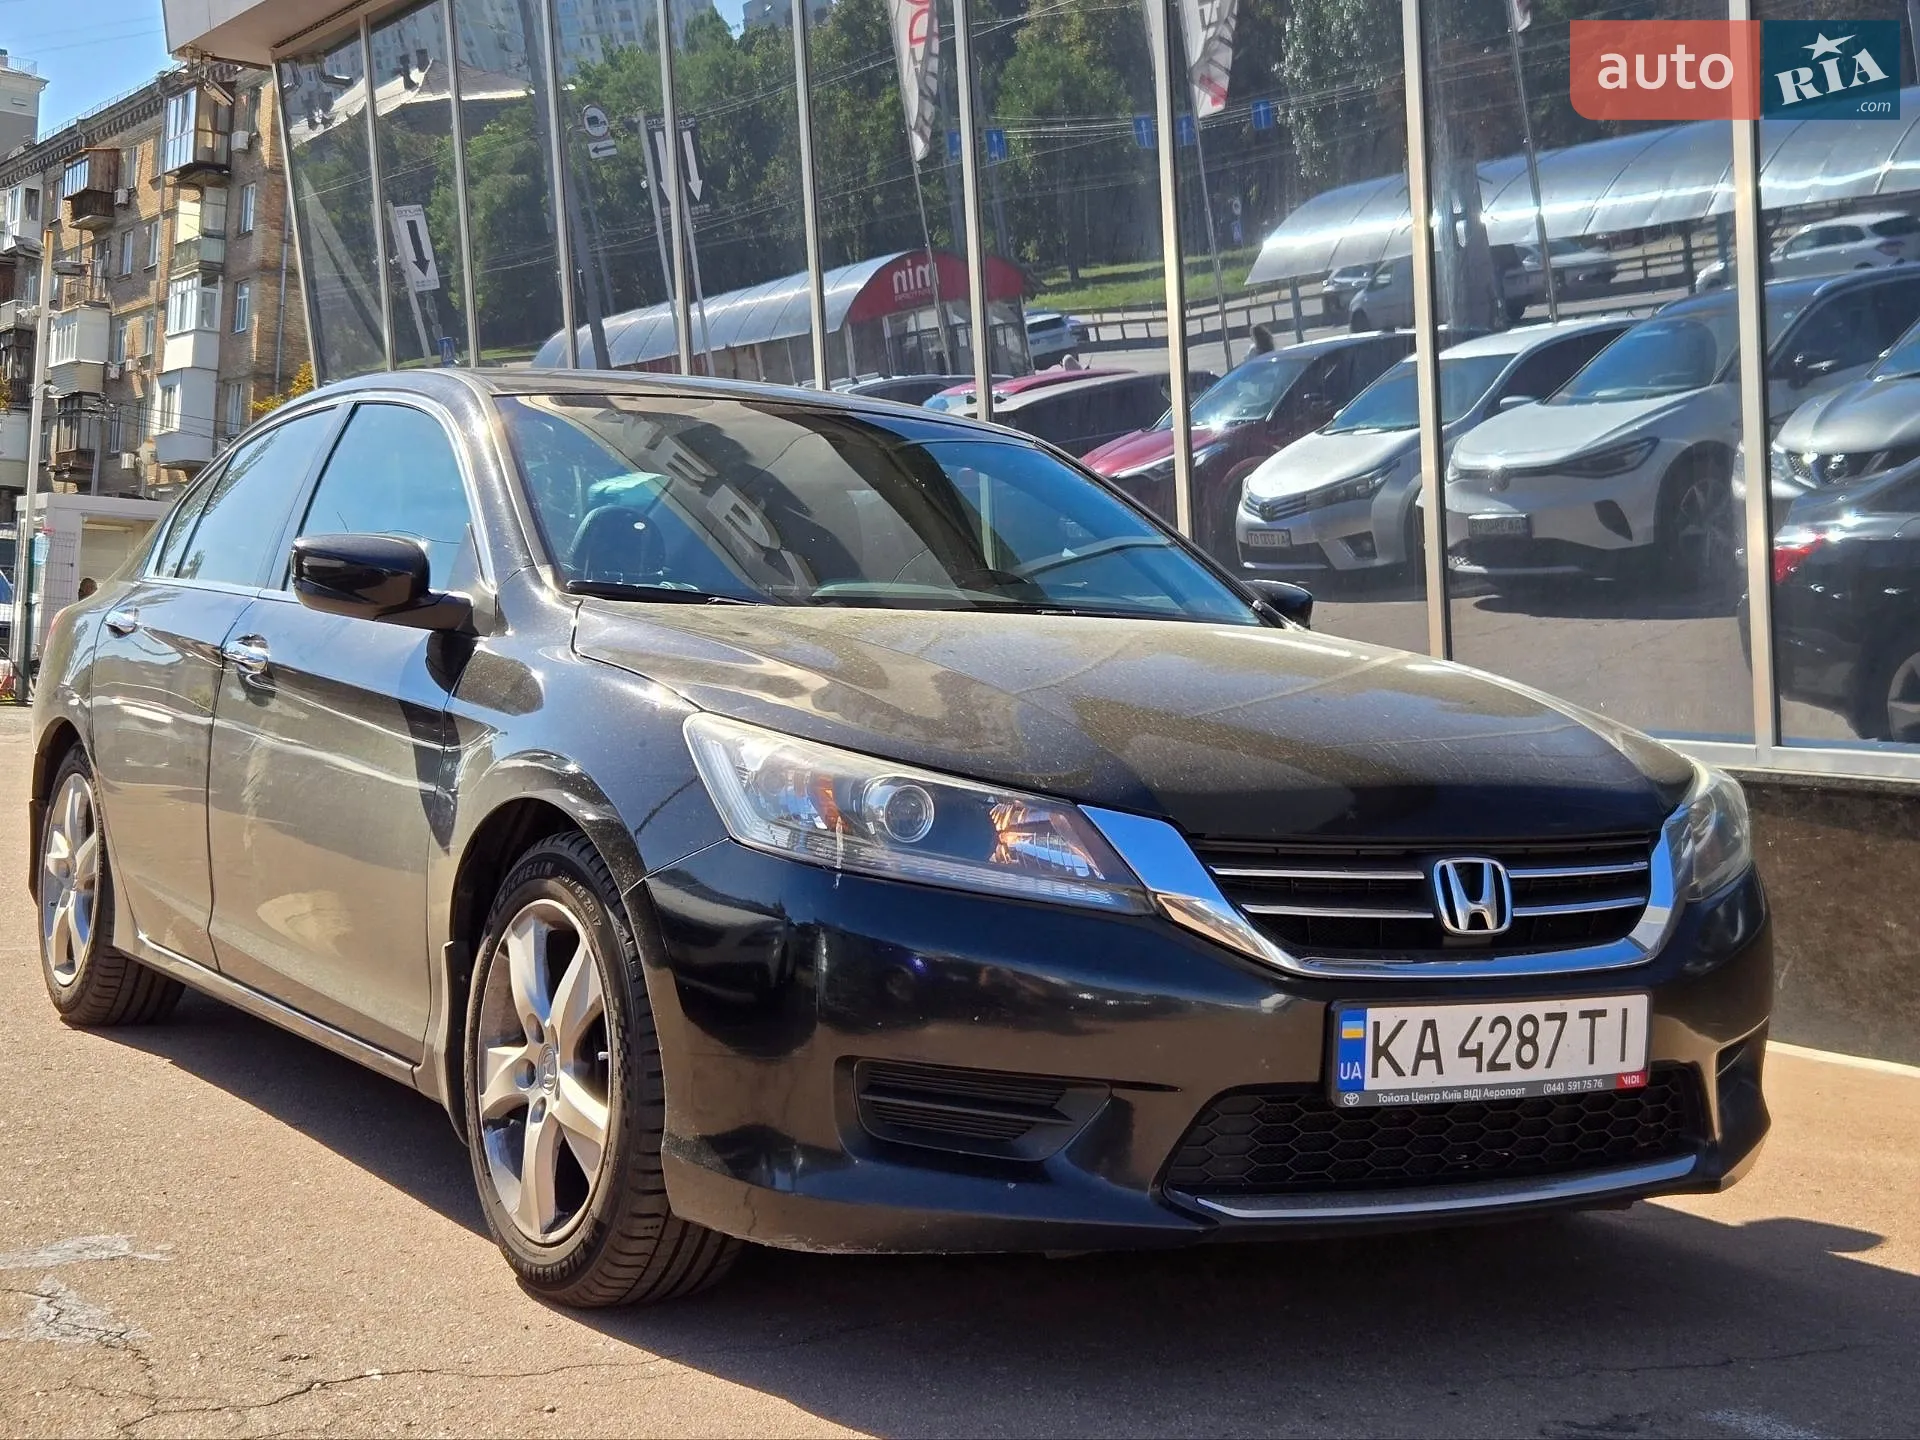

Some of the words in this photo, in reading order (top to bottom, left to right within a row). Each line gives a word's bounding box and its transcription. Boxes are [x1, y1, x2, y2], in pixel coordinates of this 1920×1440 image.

[1371, 1019, 1444, 1078] KA
[1458, 1012, 1568, 1073] 4287
[1340, 1062, 1362, 1080] UA
[1543, 1082, 1565, 1095] (044)
[1622, 1075, 1640, 1086] VIDI
[1377, 1092, 1410, 1103] Тойота
[1411, 1091, 1441, 1103] Центр
[1442, 1089, 1462, 1100] Київ
[1483, 1087, 1526, 1100] Аеропорт
